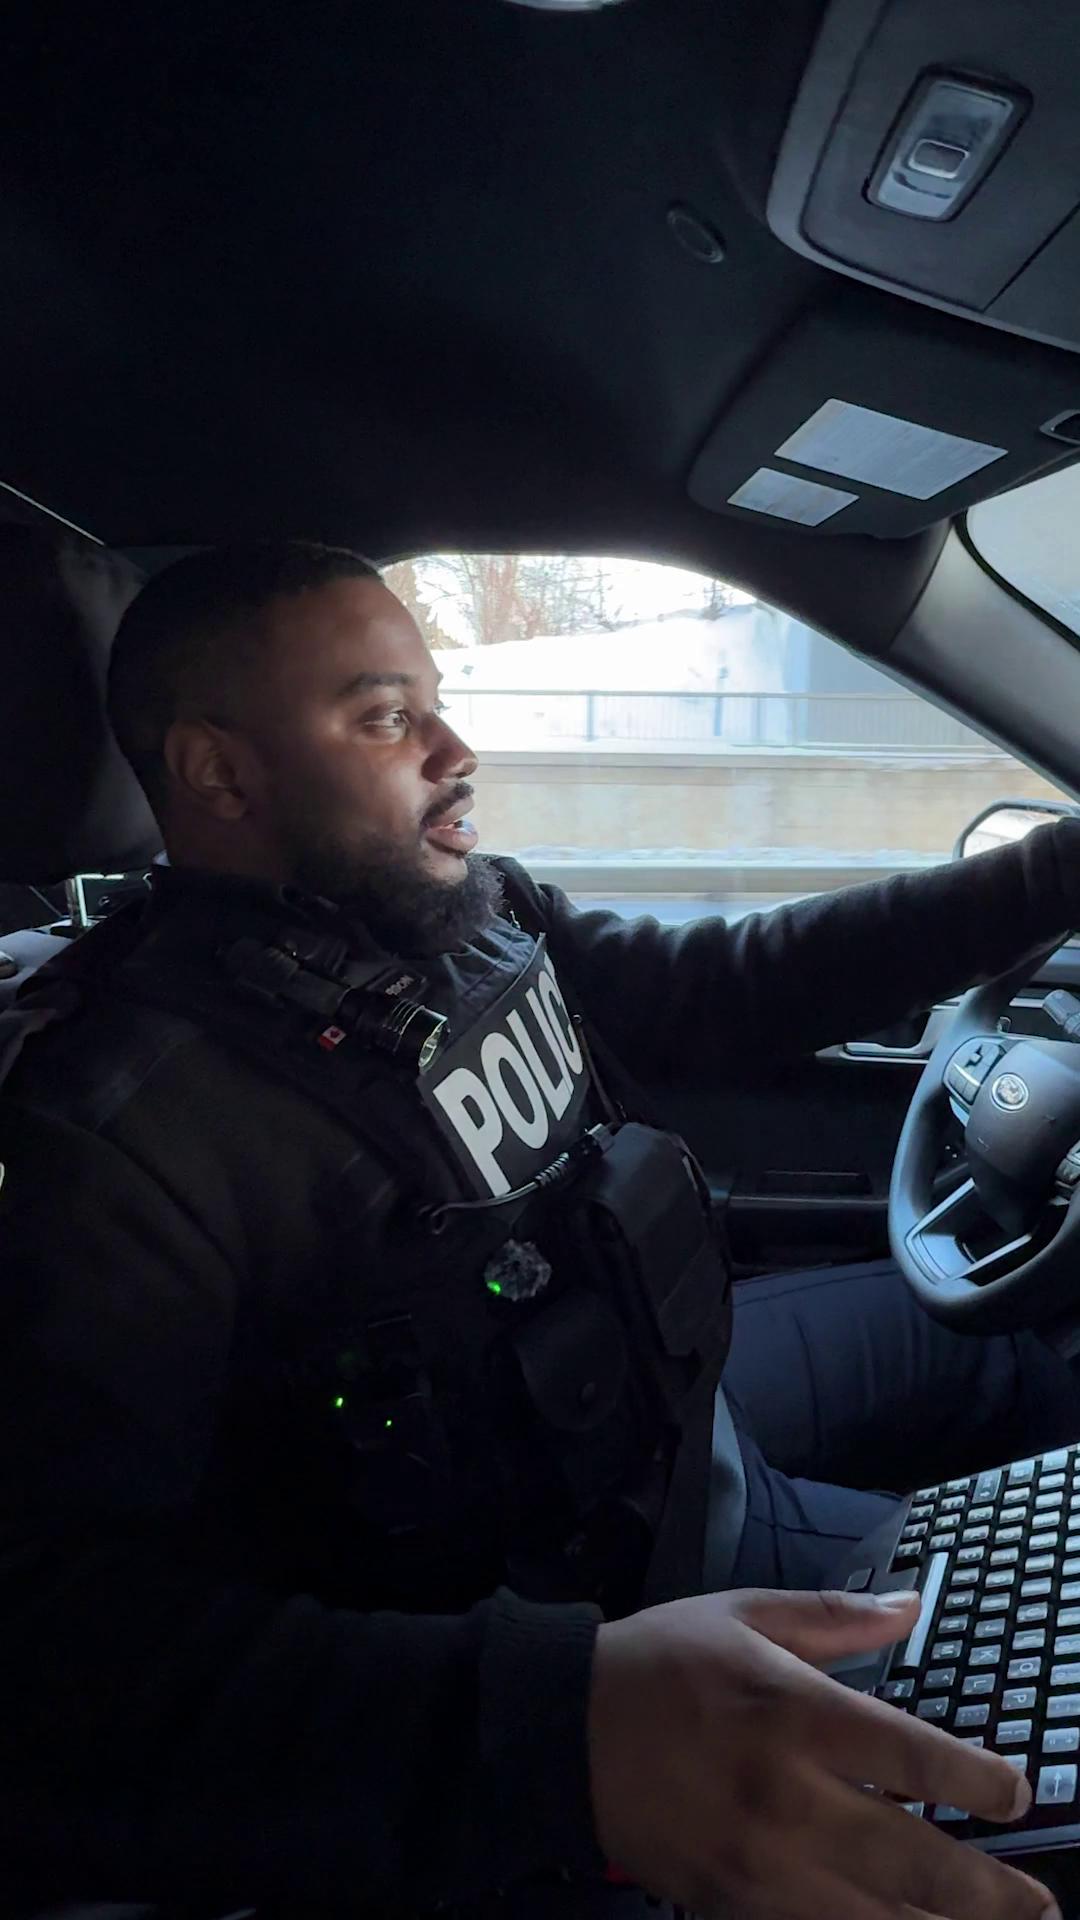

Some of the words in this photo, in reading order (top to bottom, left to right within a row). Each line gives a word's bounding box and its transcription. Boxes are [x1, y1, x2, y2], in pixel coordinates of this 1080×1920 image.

[432, 951, 584, 1198] POLIC
[974, 1679, 987, 1688] L
[1013, 1694, 1027, 1703] P
